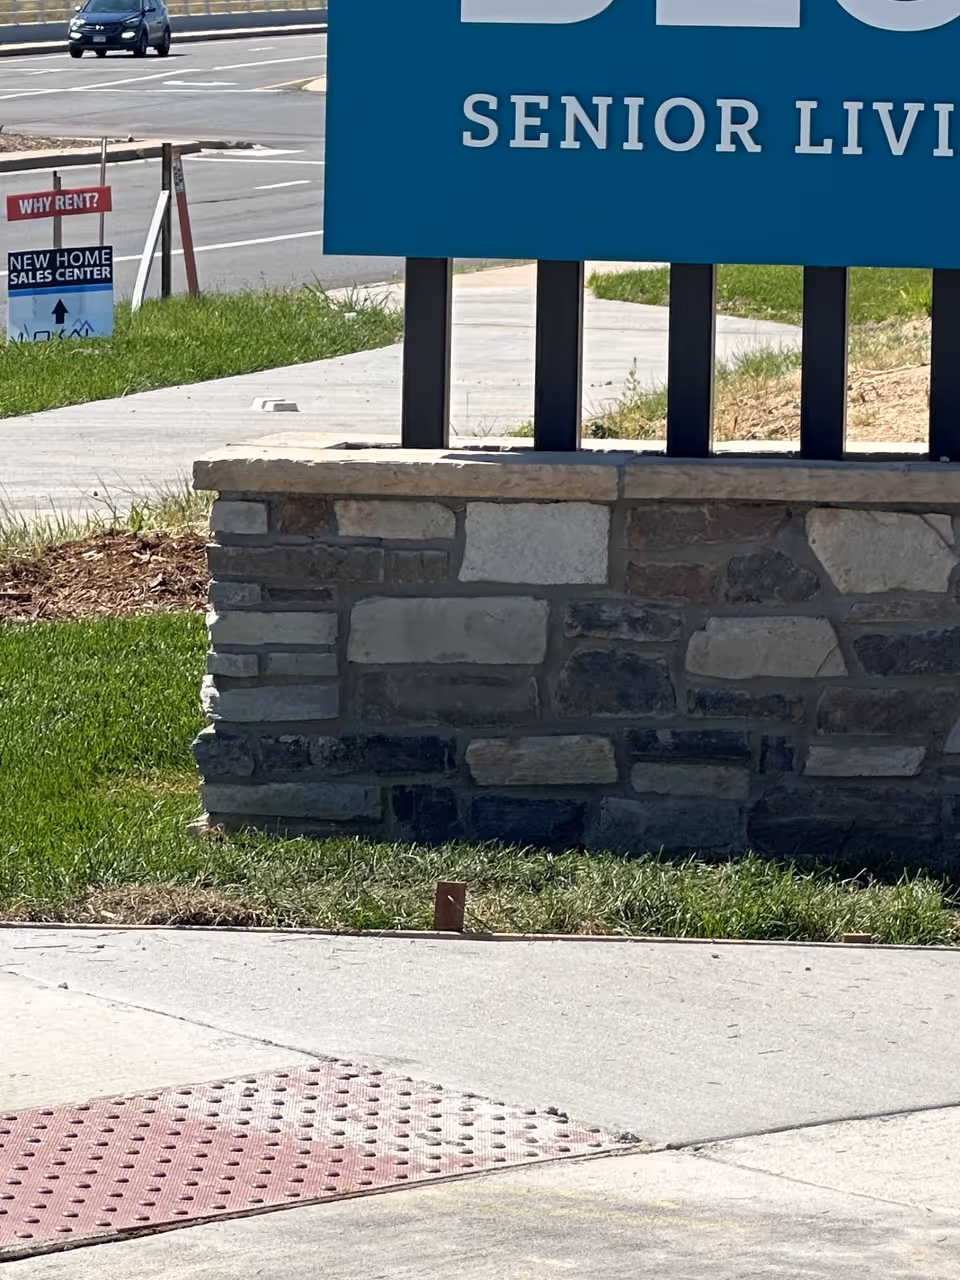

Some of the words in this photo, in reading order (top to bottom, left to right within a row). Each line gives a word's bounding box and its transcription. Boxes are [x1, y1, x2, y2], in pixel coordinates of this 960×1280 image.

[462, 93, 763, 154] SENIOR
[18, 195, 52, 215] WHY
[55, 192, 99, 210] RENT?
[10, 253, 50, 270] NEW
[56, 249, 111, 267] HOME
[10, 270, 52, 285] SALES
[55, 267, 111, 281] CENTER
